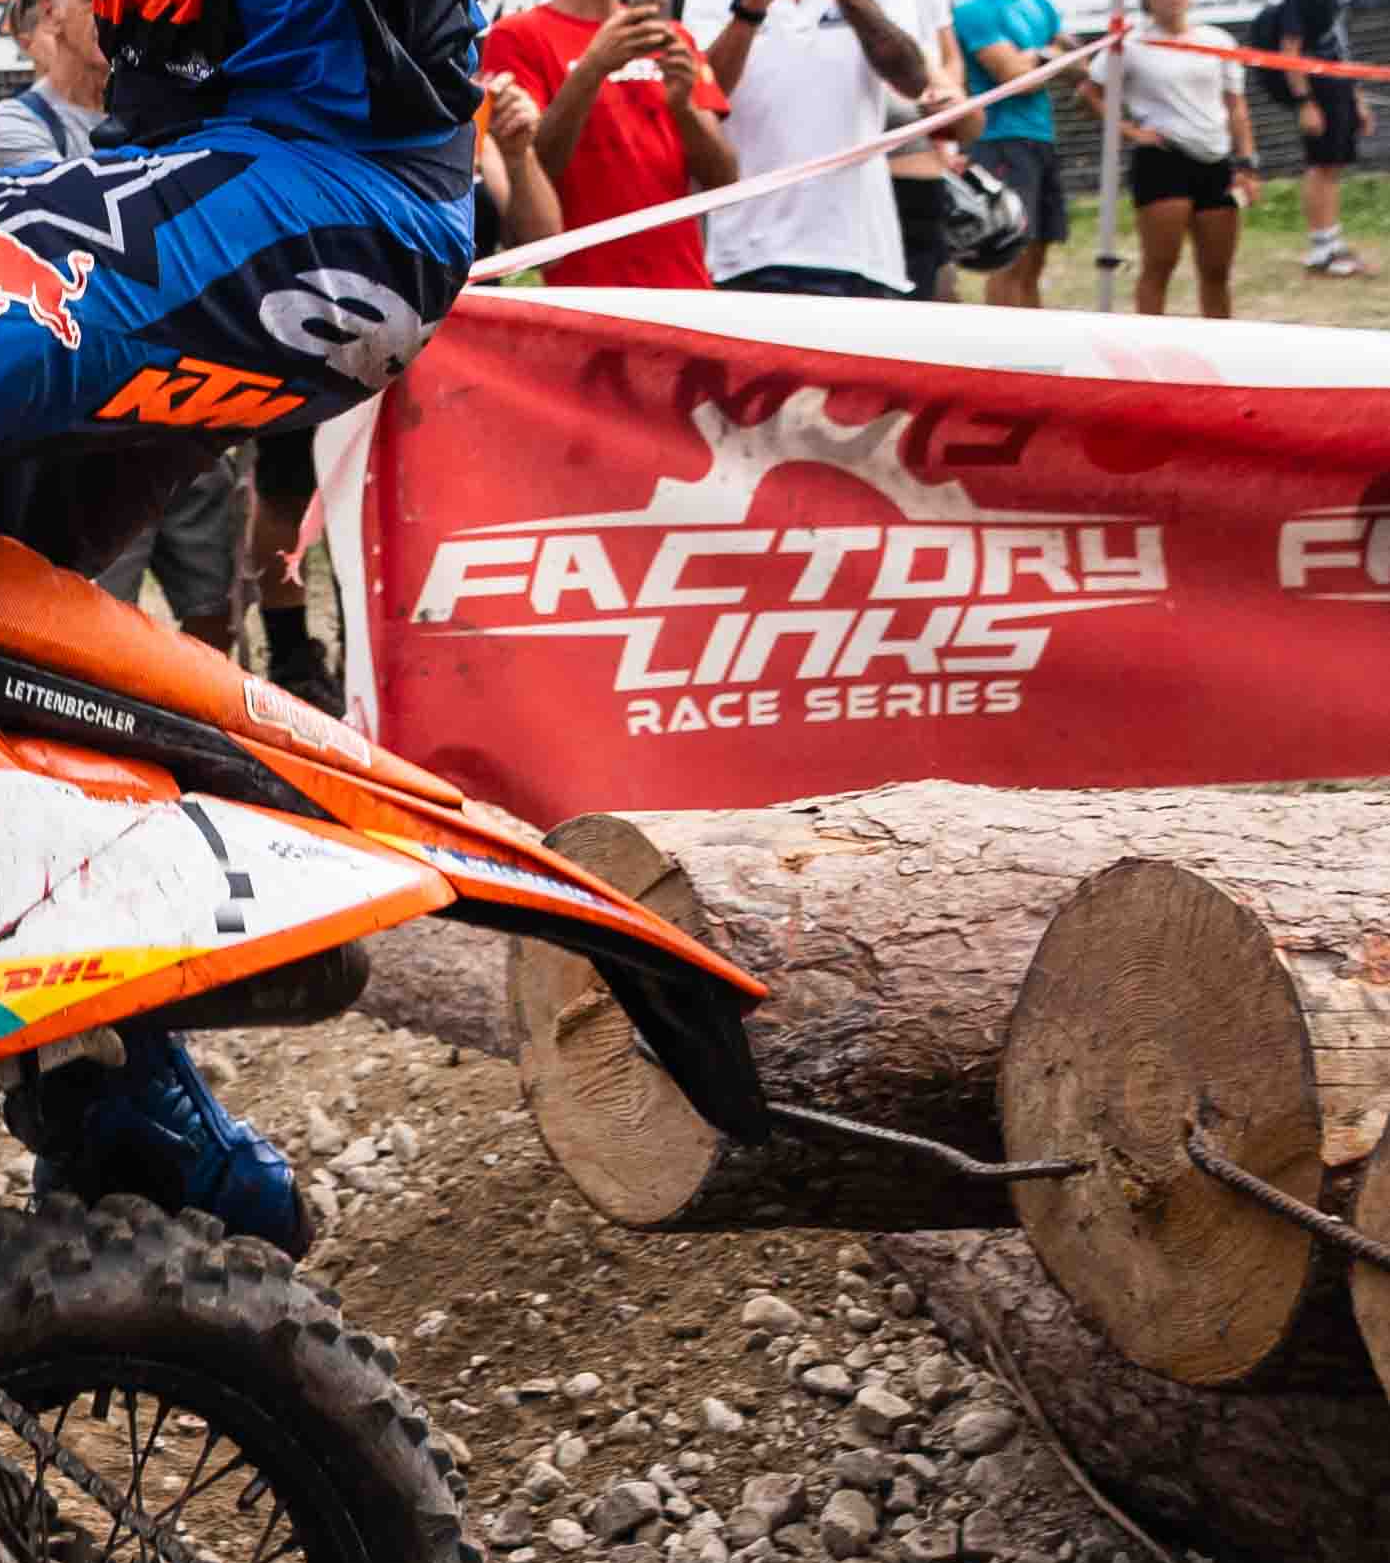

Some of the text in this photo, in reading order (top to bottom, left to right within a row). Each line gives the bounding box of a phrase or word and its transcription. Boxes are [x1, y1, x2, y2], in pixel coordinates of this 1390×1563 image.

[93, 356, 308, 429] KTM
[411, 523, 1168, 623] FACTORY
[614, 605, 1055, 693] LINKS
[5, 677, 136, 734] LETTENBICHLER
[626, 680, 1021, 736] RACE SERIES
[2, 959, 110, 993] DHL
